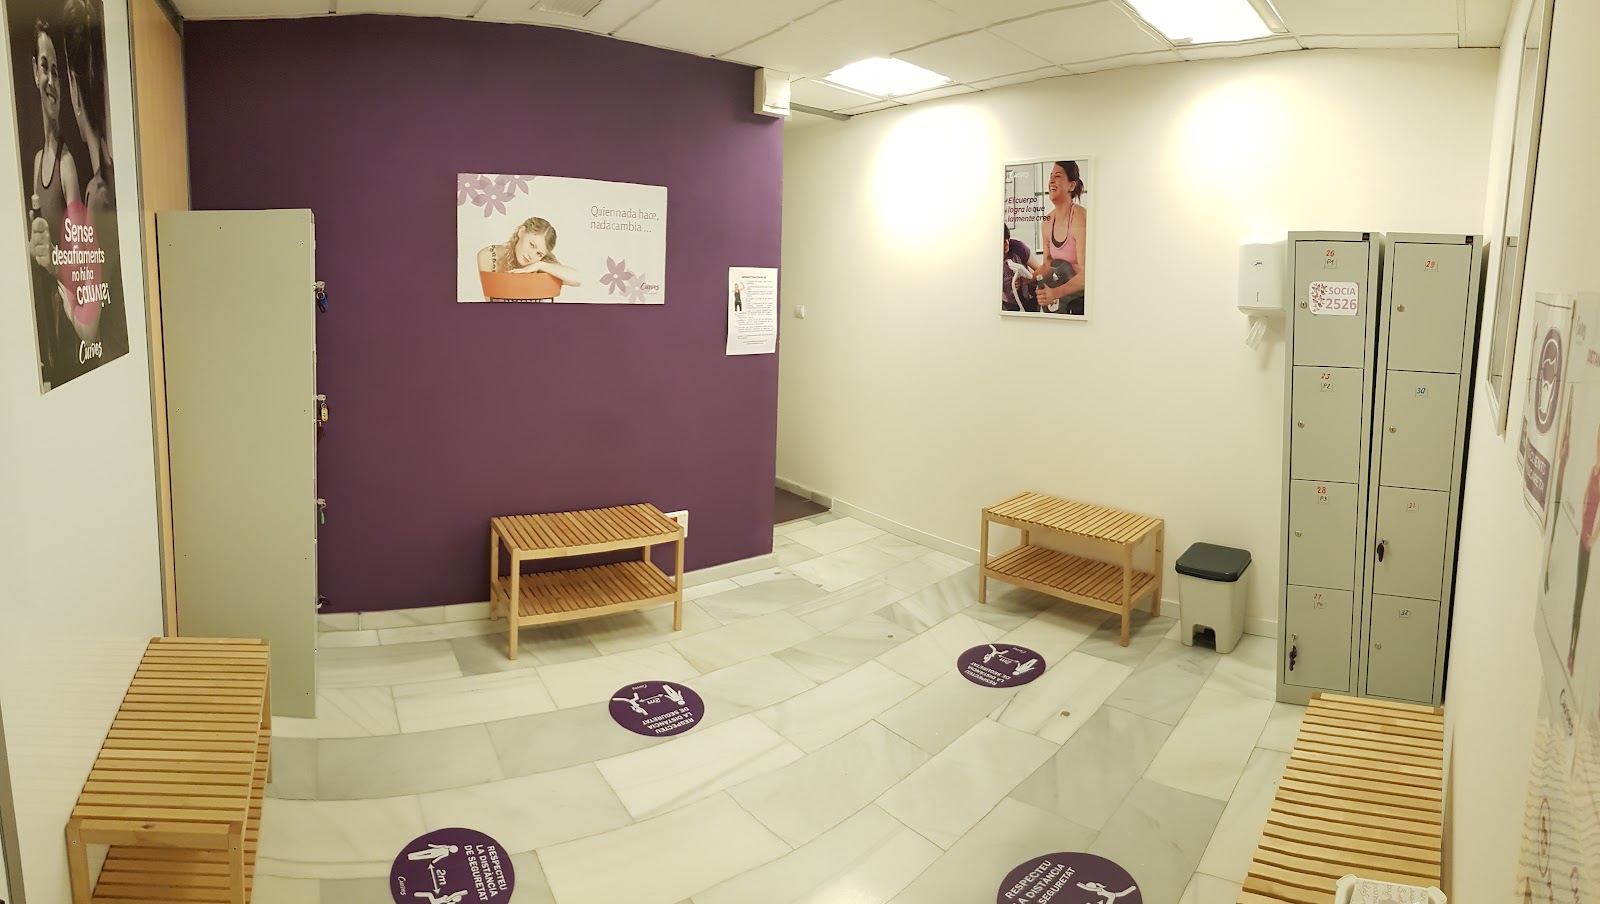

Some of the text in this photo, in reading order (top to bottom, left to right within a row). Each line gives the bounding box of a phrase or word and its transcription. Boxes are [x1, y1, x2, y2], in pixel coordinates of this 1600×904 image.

[1008, 206, 1025, 214] logra
[65, 217, 94, 243] Sense
[52, 244, 105, 266] desafiaments
[1328, 287, 1356, 296] SOCIA
[1326, 298, 1357, 310] 2526
[79, 340, 103, 364] Curves
[1317, 486, 1327, 494] 28
[642, 712, 680, 726] SEGURETAT
[655, 718, 694, 734] RESPECTEU
[476, 844, 486, 856] LA
[464, 844, 488, 901] DE SEGURETAT
[486, 846, 508, 890] RESPECTEU
[398, 876, 406, 896] Curves
[436, 870, 447, 885] 2m
[1004, 860, 1052, 899] RESPECTEU
[1038, 866, 1076, 904] SEGURETAT
